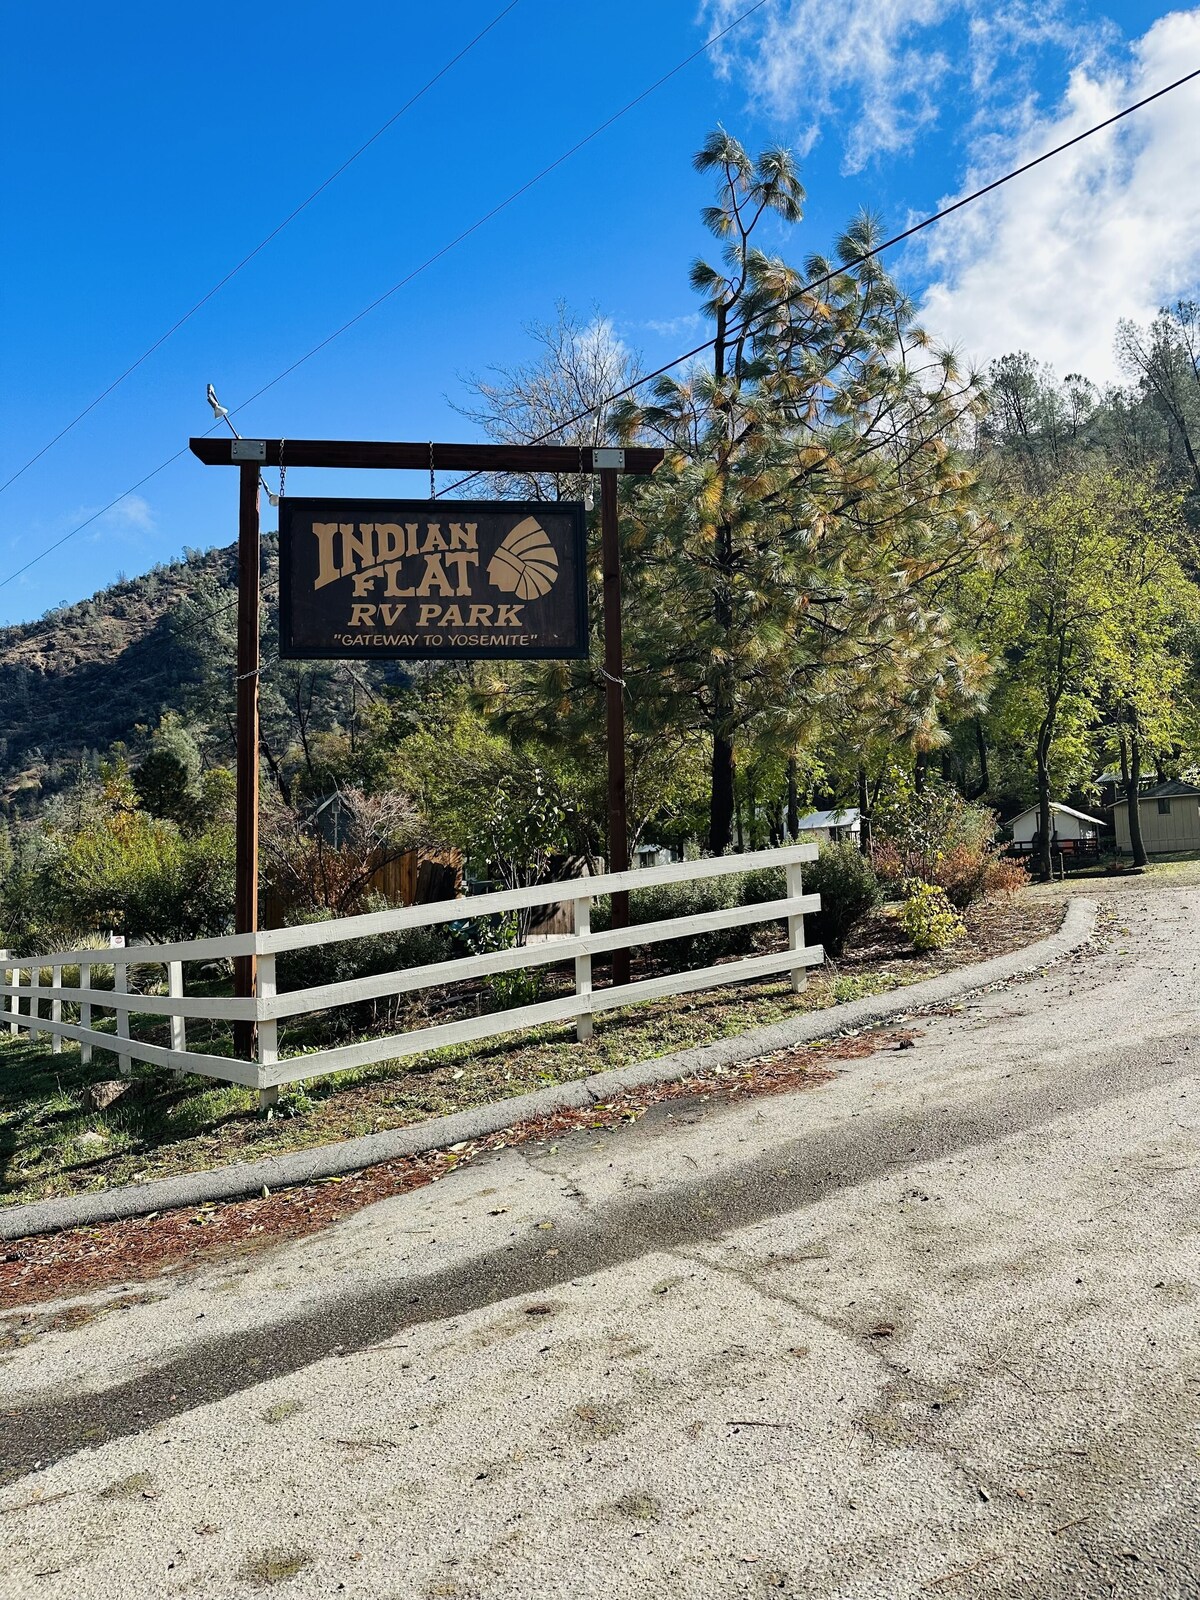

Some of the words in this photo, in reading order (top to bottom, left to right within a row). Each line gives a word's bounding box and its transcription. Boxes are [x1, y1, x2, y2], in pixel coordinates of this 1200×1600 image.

[312, 522, 478, 591] INDIAN
[352, 552, 479, 597] FLAT
[347, 604, 407, 627] RV
[416, 604, 525, 627] PARK
[333, 634, 419, 646] "GATEWAY
[423, 634, 443, 646] TO
[448, 634, 538, 647] YOSEMITE"
